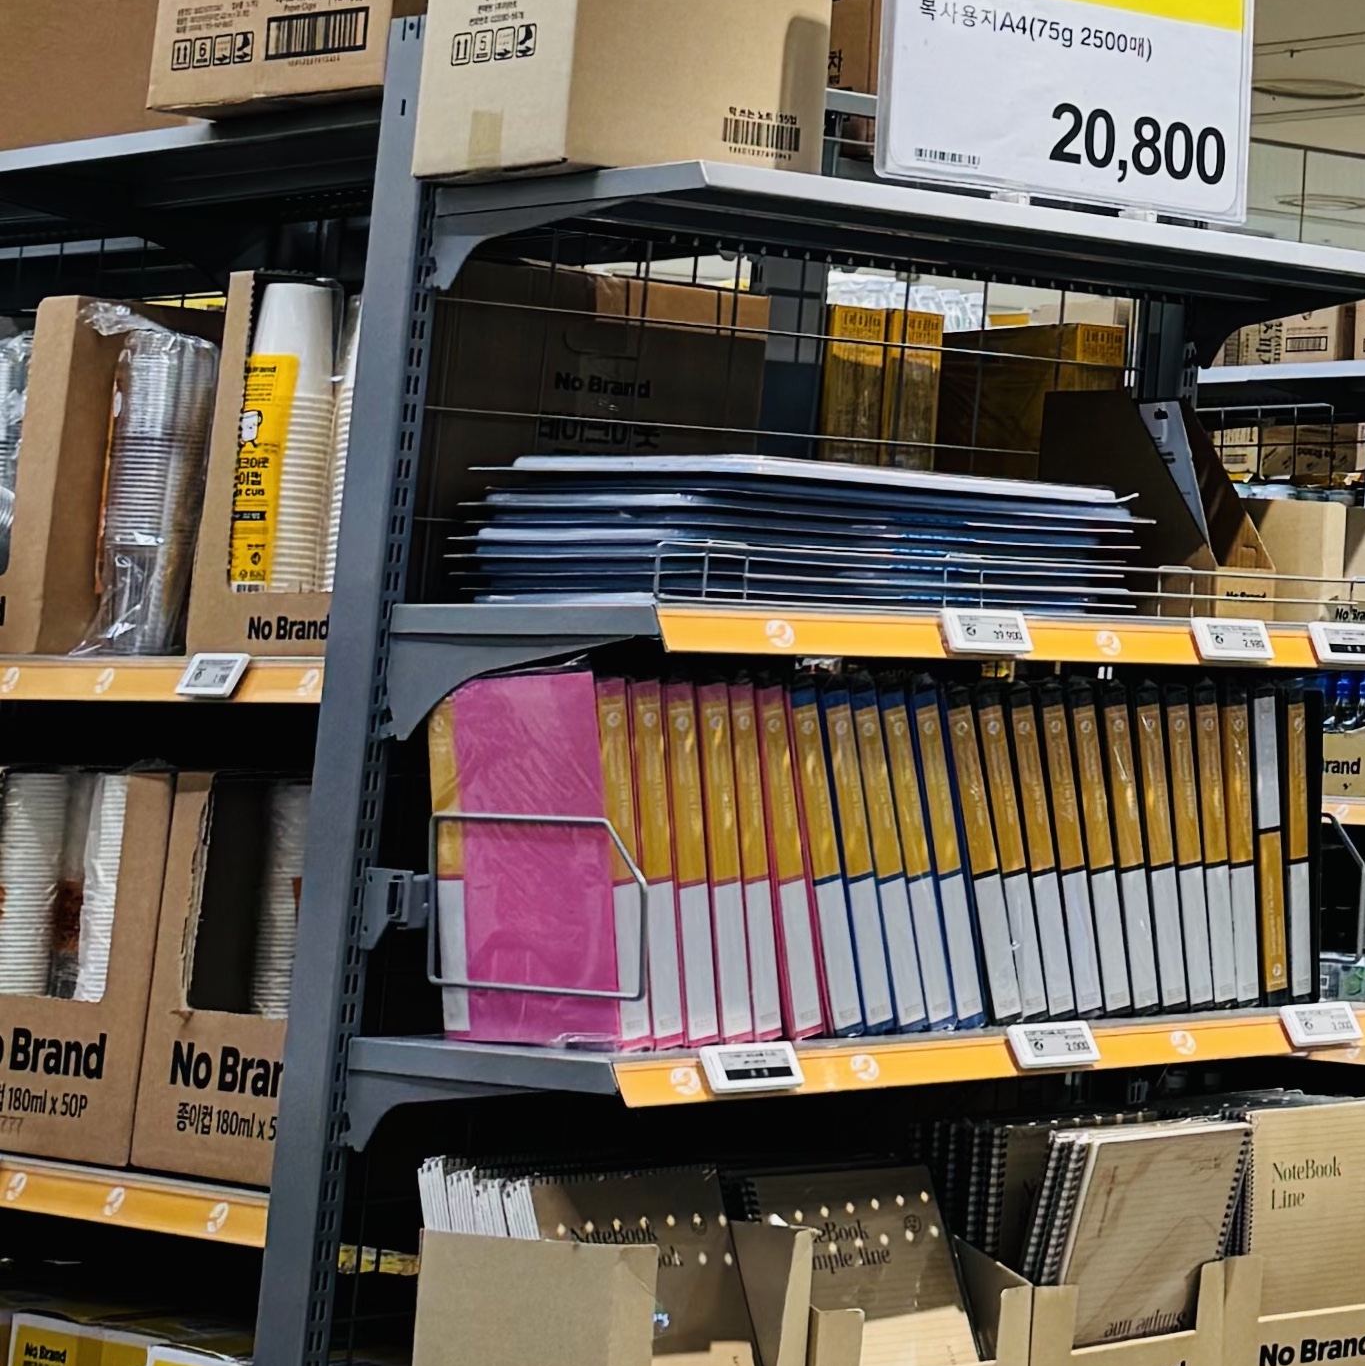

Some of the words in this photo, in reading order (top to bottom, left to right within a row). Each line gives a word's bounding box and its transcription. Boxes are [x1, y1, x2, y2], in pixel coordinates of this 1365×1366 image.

[1080, 26, 1152, 62] 2500매)
[1049, 103, 1226, 186] 20,800
[247, 616, 273, 640] No
[9, 1028, 108, 1079] Brand
[169, 1041, 211, 1087] No
[9, 1087, 46, 1113] 180ml
[49, 1097, 59, 1112] x
[60, 1093, 88, 1118] 50P
[176, 1102, 212, 1134] 종이컵
[216, 1111, 254, 1138] 180ml
[257, 1123, 266, 1137] x
[1271, 1157, 1341, 1184] NoteBook
[1271, 1190, 1305, 1210] Line
[24, 1342, 38, 1361] No
